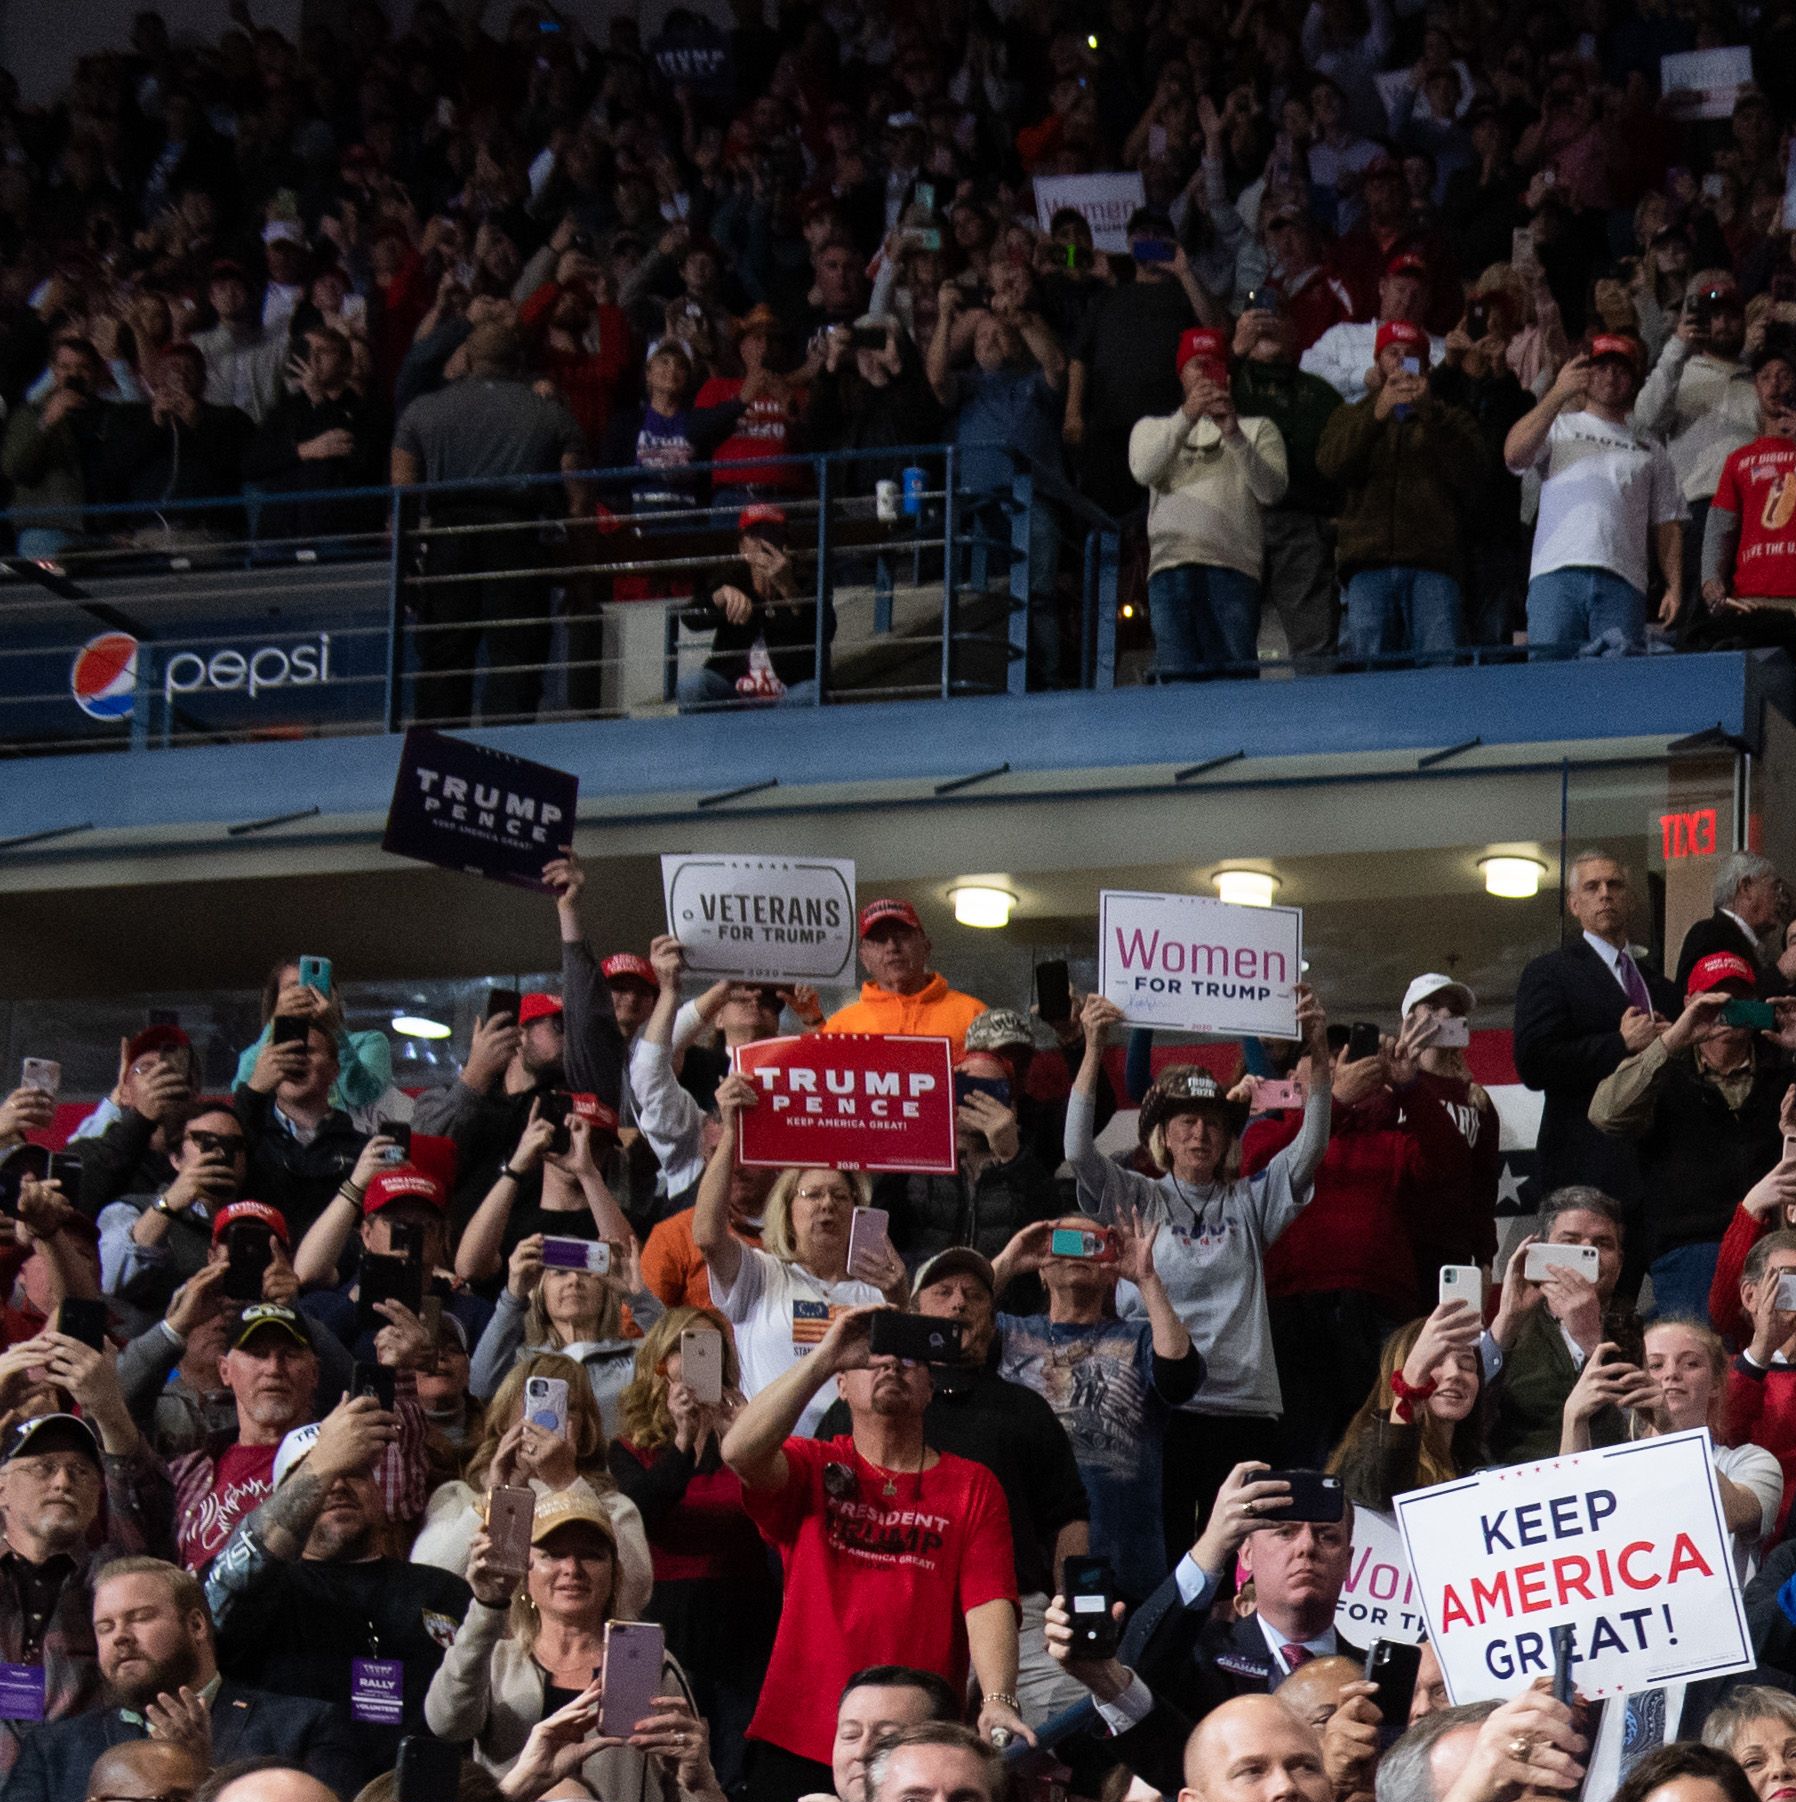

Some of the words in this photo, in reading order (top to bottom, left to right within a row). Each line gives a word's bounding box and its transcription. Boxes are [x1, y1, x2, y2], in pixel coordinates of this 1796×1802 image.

[165, 630, 332, 704] pepsi
[416, 767, 563, 827] TRUMP
[425, 798, 548, 844] PENCE
[699, 893, 842, 928] VETERANS
[719, 925, 753, 942] FOR
[763, 927, 827, 945] TRUMP
[1115, 925, 1288, 984] Women
[1134, 977, 1179, 996] FOR
[1188, 980, 1273, 1002] TRUMP
[755, 1065, 938, 1099] TRUMP
[772, 1096, 921, 1119] PENCE
[786, 1117, 815, 1129] KEEP
[817, 1118, 865, 1131] AMERICA
[867, 1120, 908, 1132] GREAT!
[1479, 1486, 1620, 1559] KEEP
[847, 1546, 897, 1564] AMERICA
[1440, 1531, 1715, 1634] AMERICA
[1216, 1657, 1269, 1677] GRAHAM
[359, 1677, 396, 1690] RALLY
[355, 1702, 400, 1714] VOLUNTEER
